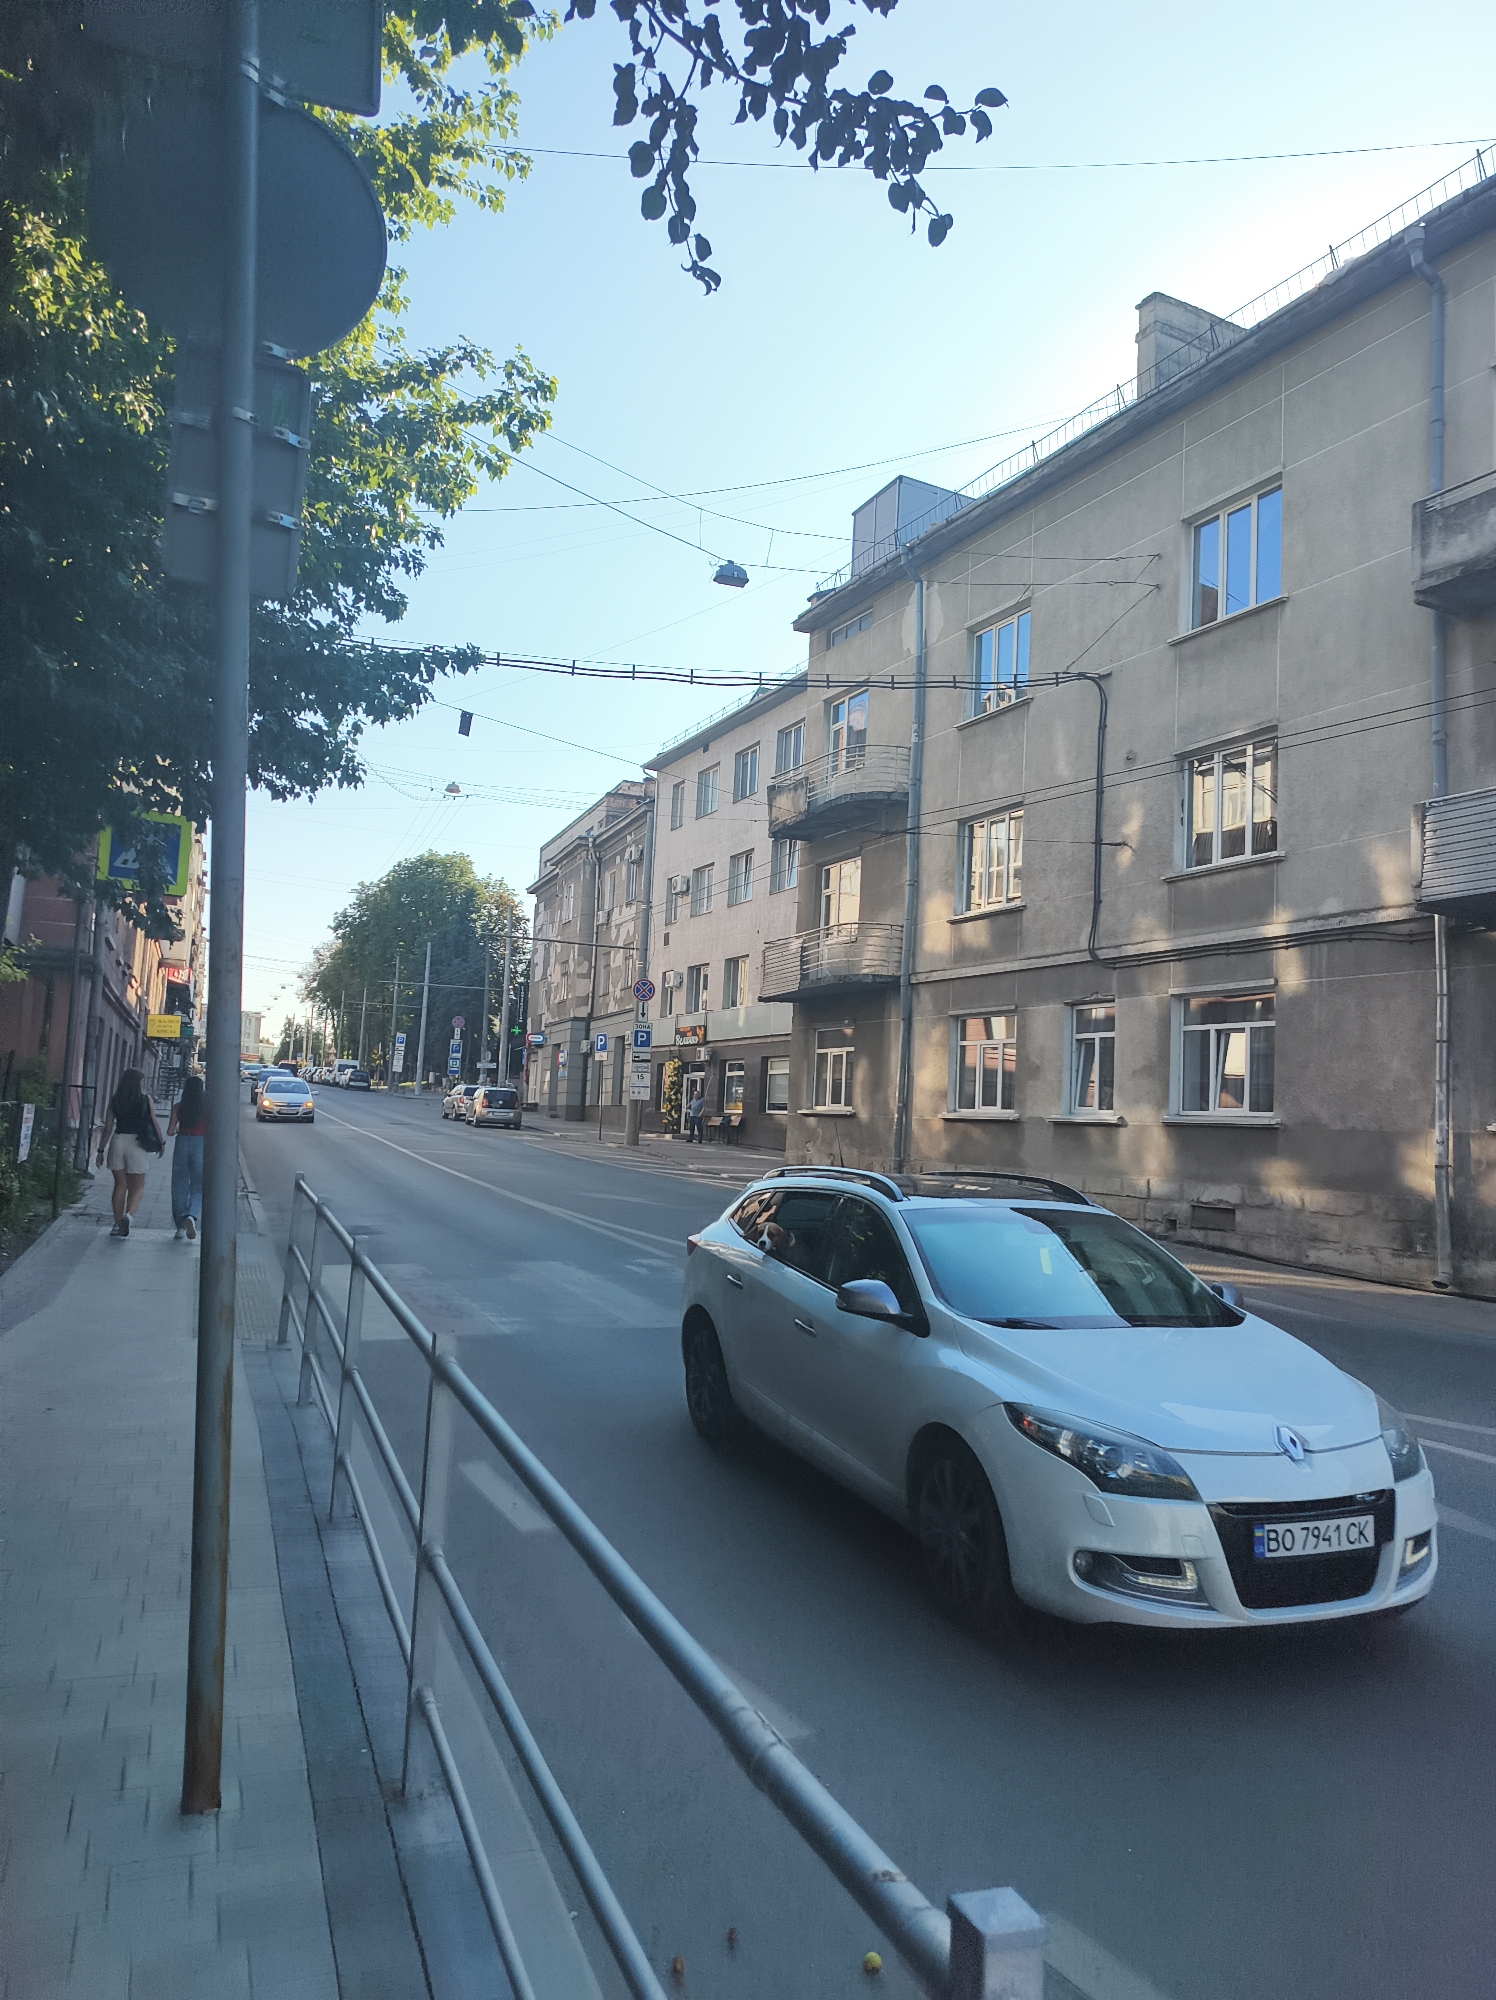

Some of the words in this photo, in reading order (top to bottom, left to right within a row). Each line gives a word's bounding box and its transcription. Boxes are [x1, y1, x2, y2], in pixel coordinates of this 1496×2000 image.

[1266, 1528, 1295, 1553] BO
[1301, 1523, 1342, 1550] 7941
[1346, 1520, 1369, 1545] CK
